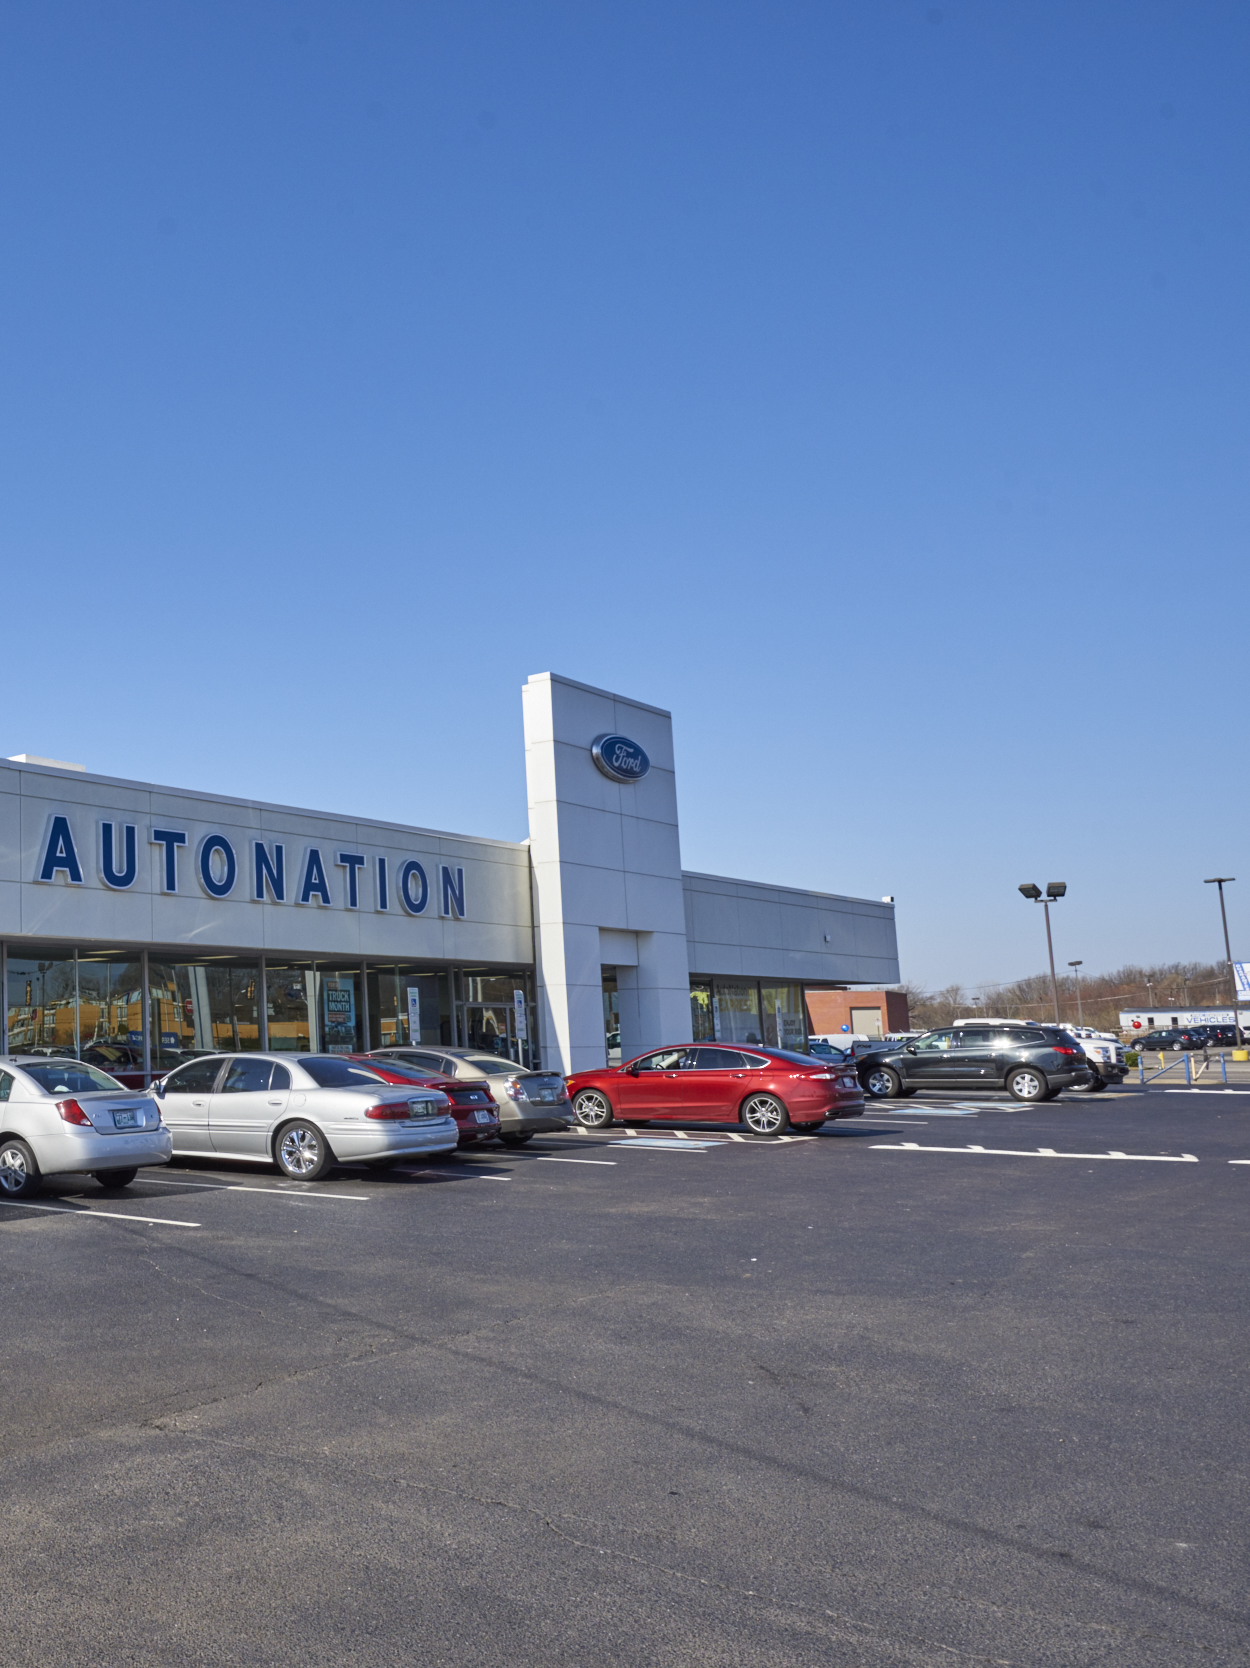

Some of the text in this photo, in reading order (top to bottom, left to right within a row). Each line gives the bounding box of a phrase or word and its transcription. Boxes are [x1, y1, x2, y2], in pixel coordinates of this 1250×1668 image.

[612, 743, 642, 772] Ford
[34, 813, 467, 919] AUTONATION
[328, 991, 349, 1002] TRUCK
[329, 1002, 350, 1011] MONTH
